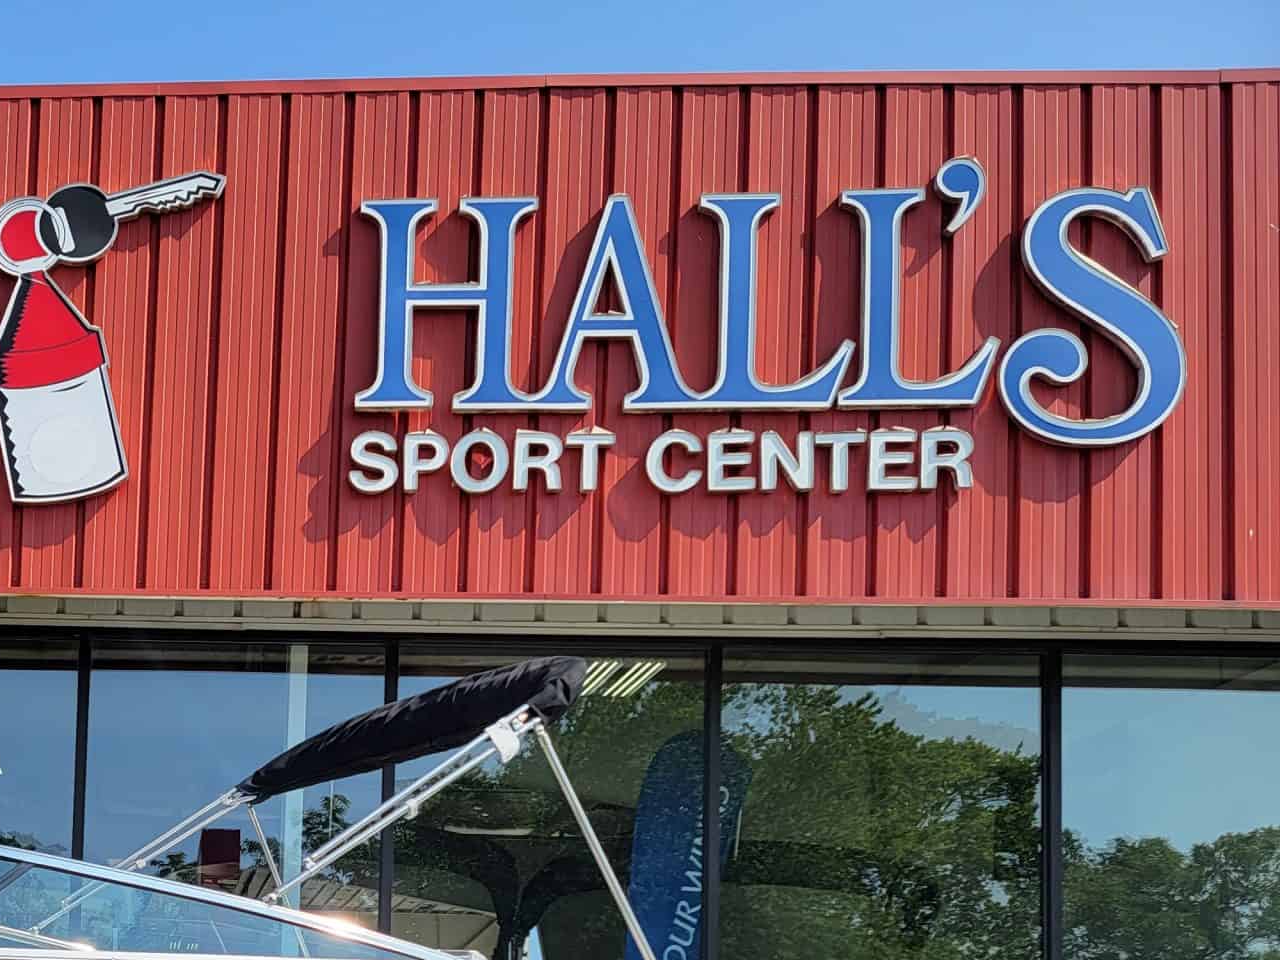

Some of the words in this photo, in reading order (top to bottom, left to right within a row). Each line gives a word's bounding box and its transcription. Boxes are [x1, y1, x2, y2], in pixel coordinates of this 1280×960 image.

[354, 155, 1187, 447] HALL'S
[347, 427, 616, 493] SPORT
[644, 427, 975, 493] CENTER
